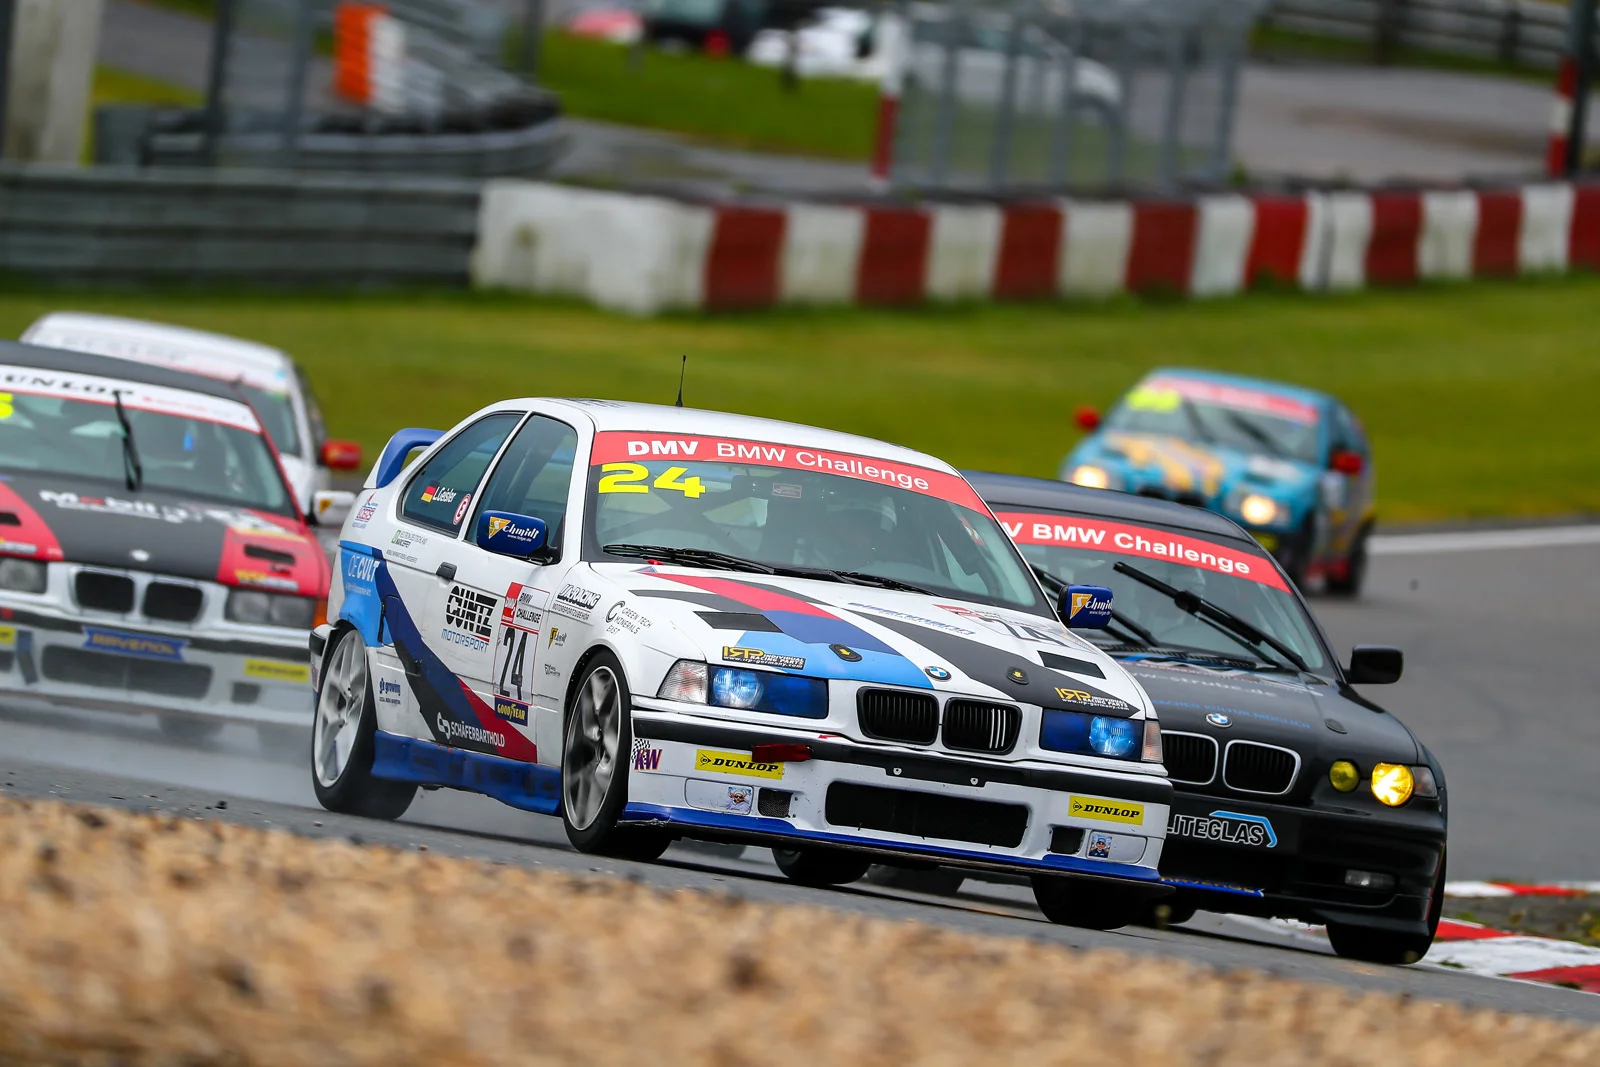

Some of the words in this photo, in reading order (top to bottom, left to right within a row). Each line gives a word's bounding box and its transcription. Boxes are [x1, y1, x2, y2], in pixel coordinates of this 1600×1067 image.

[627, 440, 698, 456] DMV
[717, 442, 786, 462] BMW
[796, 452, 929, 490] Challenge
[598, 462, 706, 498] 24
[1033, 523, 1106, 544] BMW
[1114, 533, 1251, 575] Challenge
[519, 592, 533, 604] BMW
[516, 608, 542, 624] CHALLENGE
[614, 615, 641, 635] MINERALS
[621, 606, 641, 622] GREEN
[638, 615, 654, 629] TECH
[441, 628, 489, 653] MOTORSPORT
[500, 627, 528, 700] 24
[497, 703, 526, 720] GOODYEAR
[450, 721, 506, 748] SCHÄFERBARTHOLD
[634, 749, 663, 771] KW
[712, 757, 779, 773] DUNLOP
[1083, 803, 1141, 819] DUNLOP
